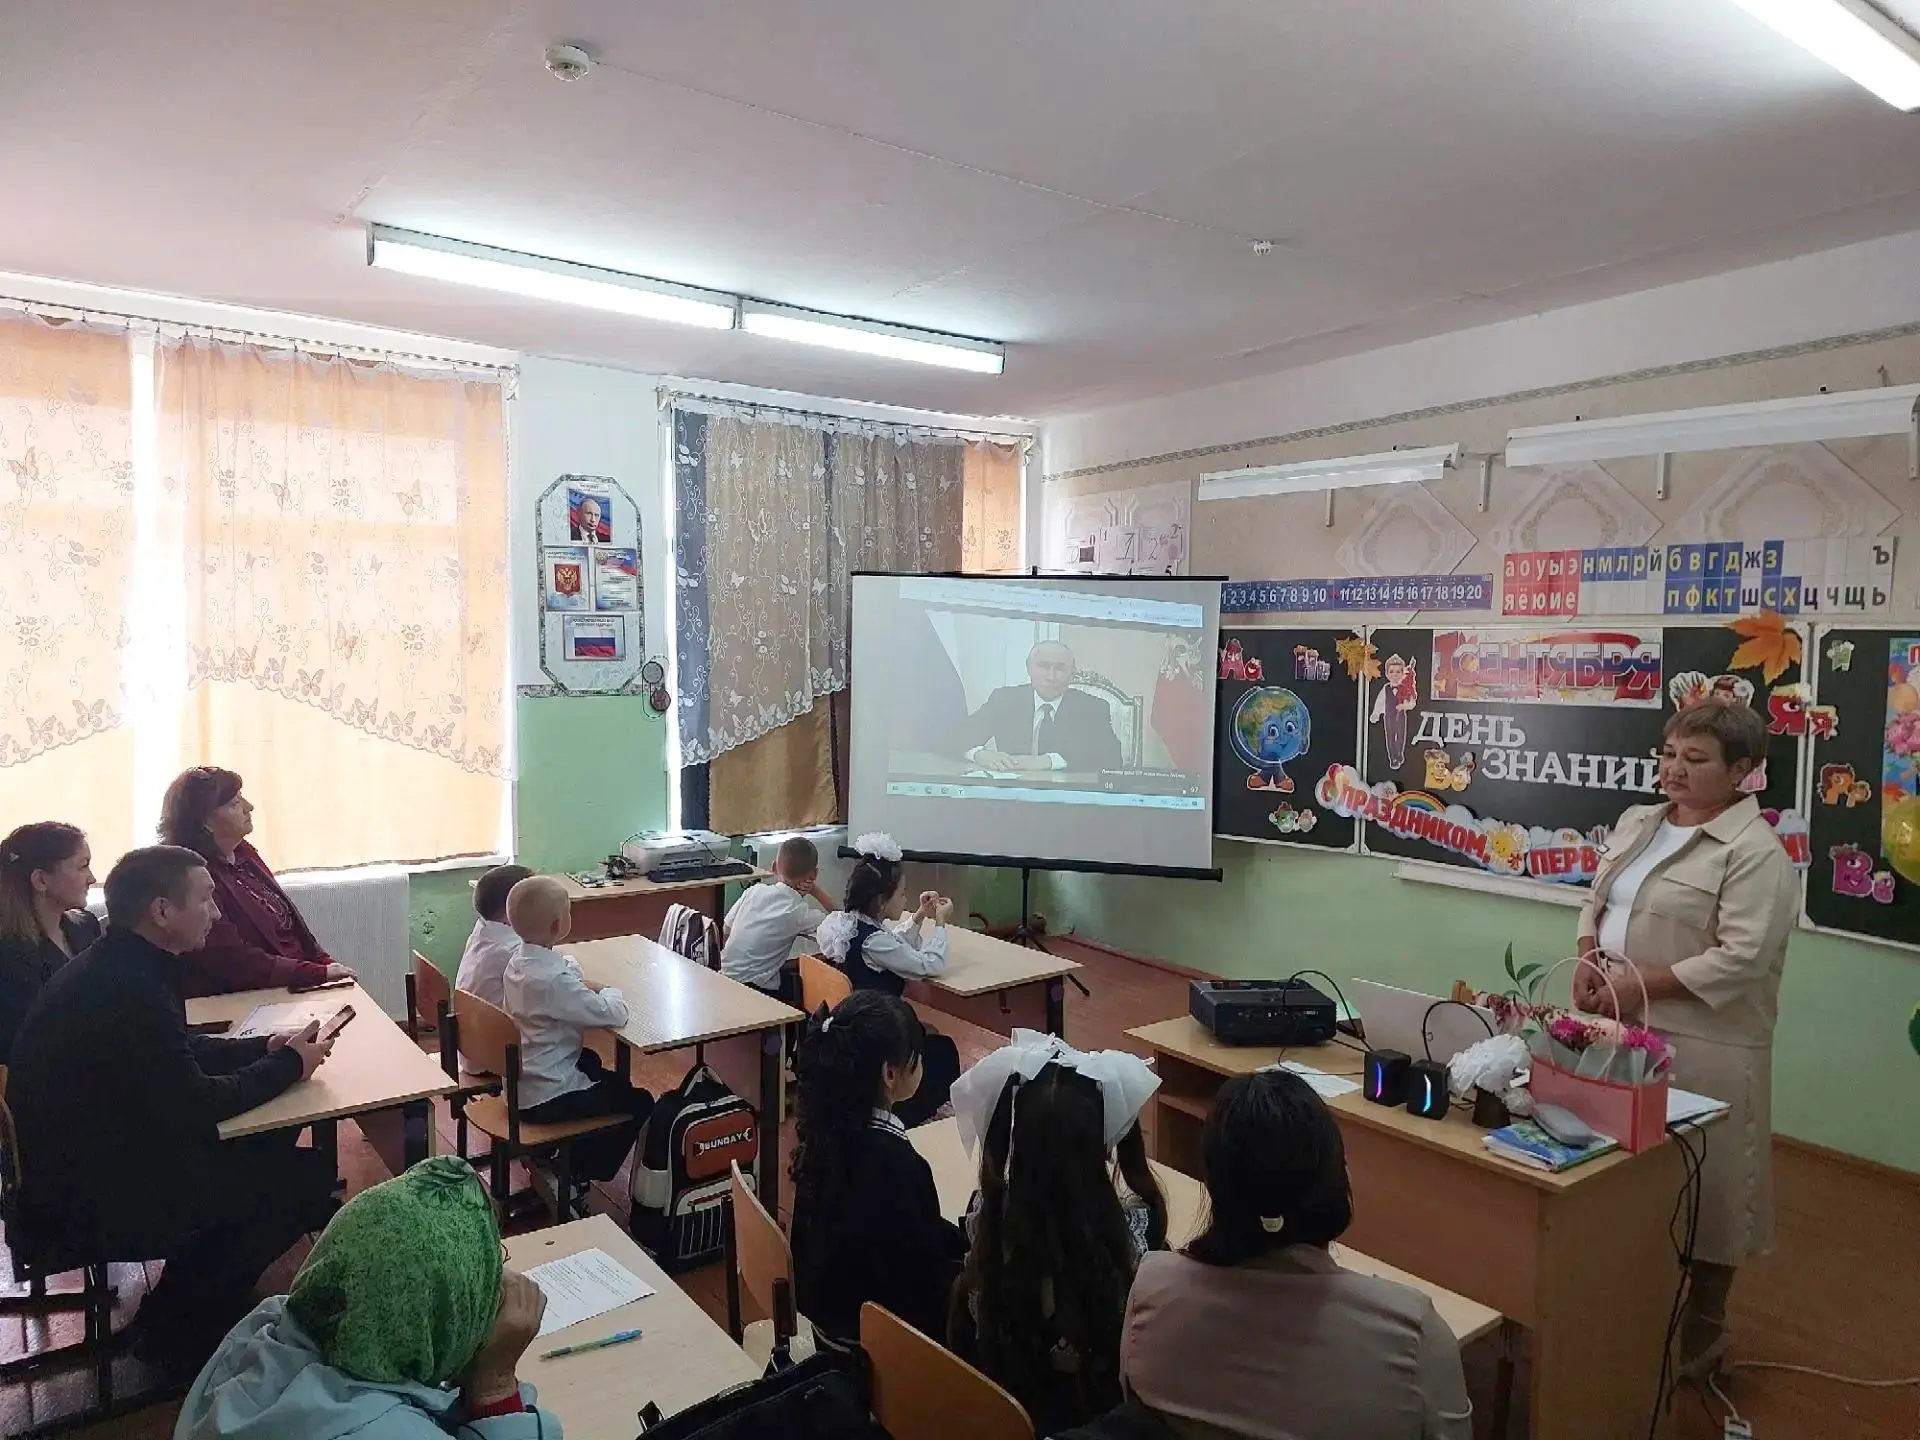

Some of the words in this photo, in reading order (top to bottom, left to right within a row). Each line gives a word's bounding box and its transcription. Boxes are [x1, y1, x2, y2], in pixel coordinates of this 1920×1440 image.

[1505, 560, 1515, 577] а
[1519, 560, 1530, 576] о
[1536, 558, 1547, 580] у
[1550, 559, 1564, 575] ы
[1568, 558, 1578, 576] э
[1583, 558, 1595, 574] н
[1599, 558, 1612, 573] м
[1616, 557, 1629, 573] л
[1632, 556, 1645, 577] р
[1650, 547, 1662, 572] й
[1669, 547, 1682, 571] б
[1689, 552, 1700, 570] в
[1708, 551, 1719, 570] г
[1725, 551, 1740, 573] д
[1744, 551, 1761, 569] ж
[1765, 550, 1777, 569] з
[1872, 545, 1890, 565] ъ
[1230, 590, 1237, 604] 2
[1239, 590, 1247, 604] 3
[1249, 590, 1257, 604] 4
[1259, 589, 1267, 603] 5
[1269, 589, 1277, 603] 6
[1280, 588, 1287, 603] 7
[1290, 588, 1298, 603] 8
[1302, 588, 1310, 603] 9
[1312, 587, 1327, 603] 10
[1340, 589, 1350, 601] 11
[1351, 588, 1363, 601] 12
[1364, 587, 1377, 601] 13
[1379, 586, 1390, 601] 14
[1392, 586, 1405, 600] 15
[1406, 586, 1418, 600] 16
[1420, 585, 1434, 600] 17
[1435, 585, 1449, 600] 18
[1451, 584, 1464, 599] 19
[1466, 584, 1482, 599] 20
[1504, 594, 1515, 610] я
[1518, 587, 1528, 610] ё
[1532, 594, 1547, 609] ю
[1549, 594, 1562, 609] и
[1565, 593, 1576, 609] е
[1667, 590, 1680, 607] п
[1686, 584, 1700, 611] ф
[1706, 589, 1718, 606] к
[1724, 588, 1736, 606] т
[1742, 588, 1759, 606] ш
[1764, 588, 1777, 606] с
[1783, 587, 1797, 606] х
[1804, 587, 1818, 610] ц
[1826, 587, 1839, 605] ч
[1844, 586, 1865, 610] щ
[1872, 587, 1886, 606] ь
[1451, 641, 1663, 691] СЕНТЯБРЯ
[1411, 711, 1527, 748] ДЕНЬ
[704, 1132, 742, 1150] SUNDAY
